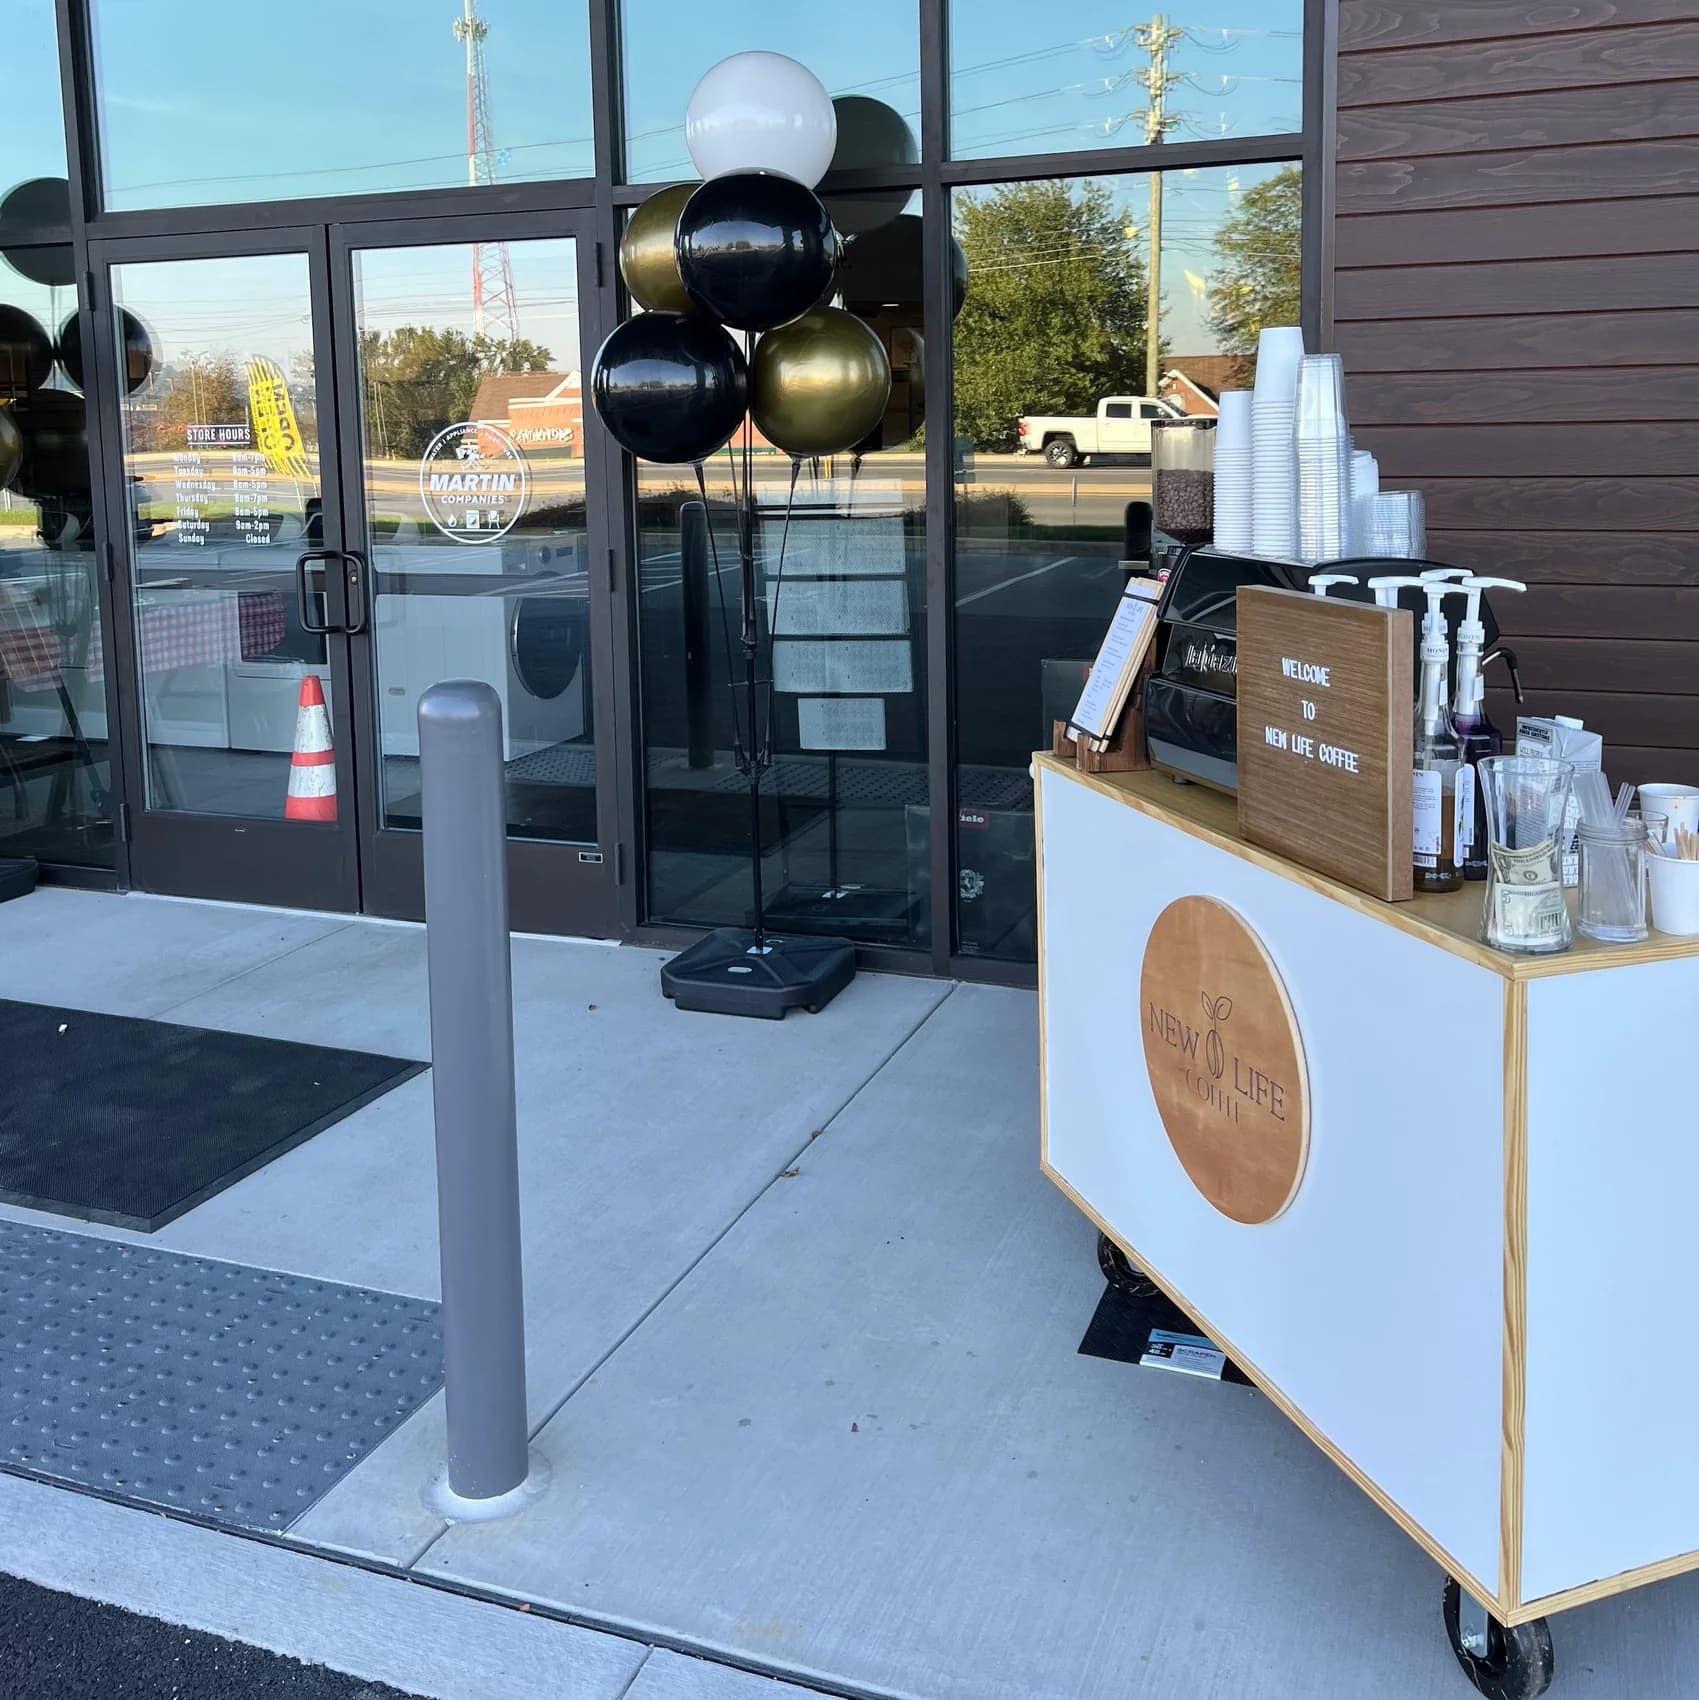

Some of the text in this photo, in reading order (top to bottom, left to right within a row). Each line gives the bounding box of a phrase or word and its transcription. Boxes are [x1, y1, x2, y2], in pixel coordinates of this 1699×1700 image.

[186, 428, 216, 441] STORE
[219, 427, 251, 440] HOURS
[446, 428, 478, 441] APPLIANCE
[173, 453, 201, 464] Monday
[174, 466, 204, 478] Tuesday
[175, 480, 216, 491] Wednesday
[429, 474, 516, 492] MARTIN
[176, 493, 208, 504] Thursday
[441, 495, 505, 505] COMPANIES
[176, 507, 199, 518] Friday
[178, 520, 270, 532] Saturday 9am-2pm
[178, 533, 271, 545] Sunday Closed
[1281, 656, 1331, 688] WELCOME
[1301, 699, 1316, 721] TO
[1265, 725, 1360, 774] NEW LIFE COFFEE
[1149, 1001, 1286, 1122] NEW LIFE
